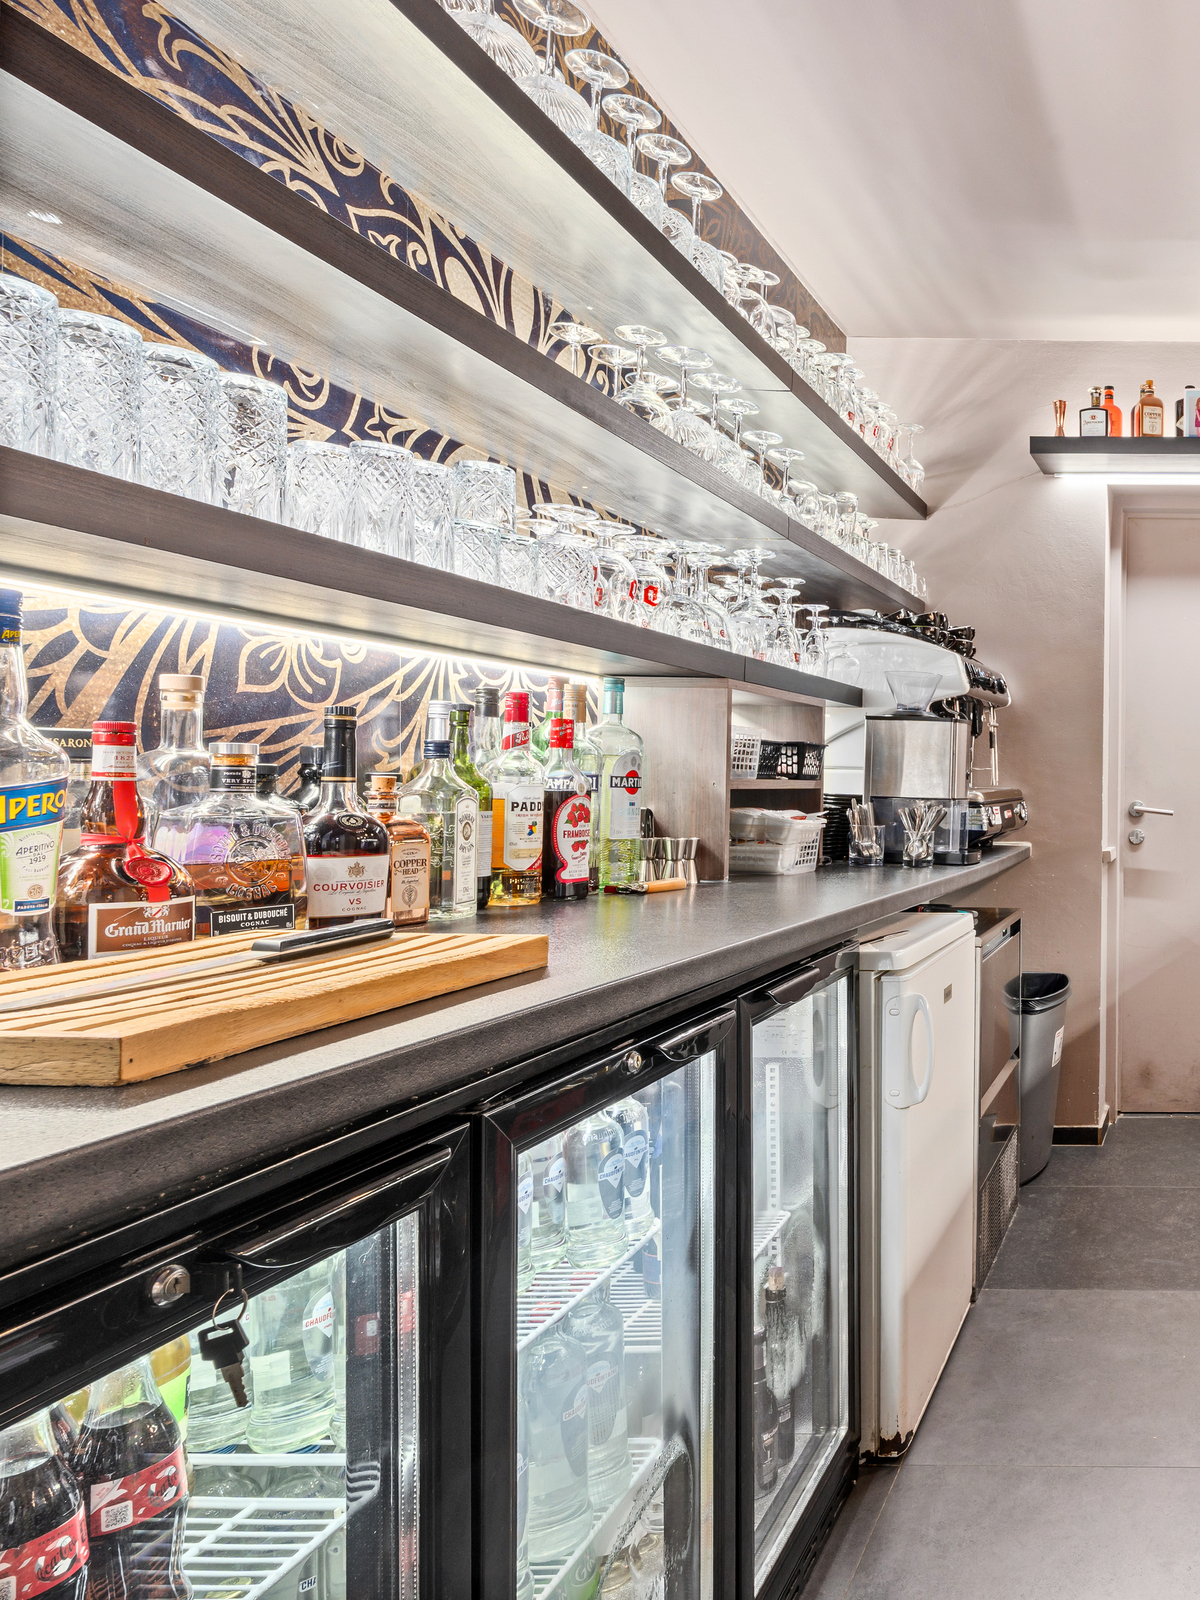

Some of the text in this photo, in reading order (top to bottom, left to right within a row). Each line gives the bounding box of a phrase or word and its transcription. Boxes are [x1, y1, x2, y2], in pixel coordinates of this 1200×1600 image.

[0, 789, 67, 824] PERO
[510, 801, 543, 812] PADD
[563, 829, 590, 839] FRAMBOISE
[15, 840, 55, 856] APERITIVO
[29, 854, 46, 865] 1919
[393, 858, 428, 869] COPPER
[402, 867, 419, 876] HEAD
[313, 879, 385, 892] COURVOISIER
[348, 897, 362, 905] VS
[218, 907, 288, 924] BISQUIT & DUBOUCHÉ
[104, 917, 192, 938] Grand Marnier
[240, 919, 270, 928] COGNAC
[143, 934, 169, 942] LIQUEUR
